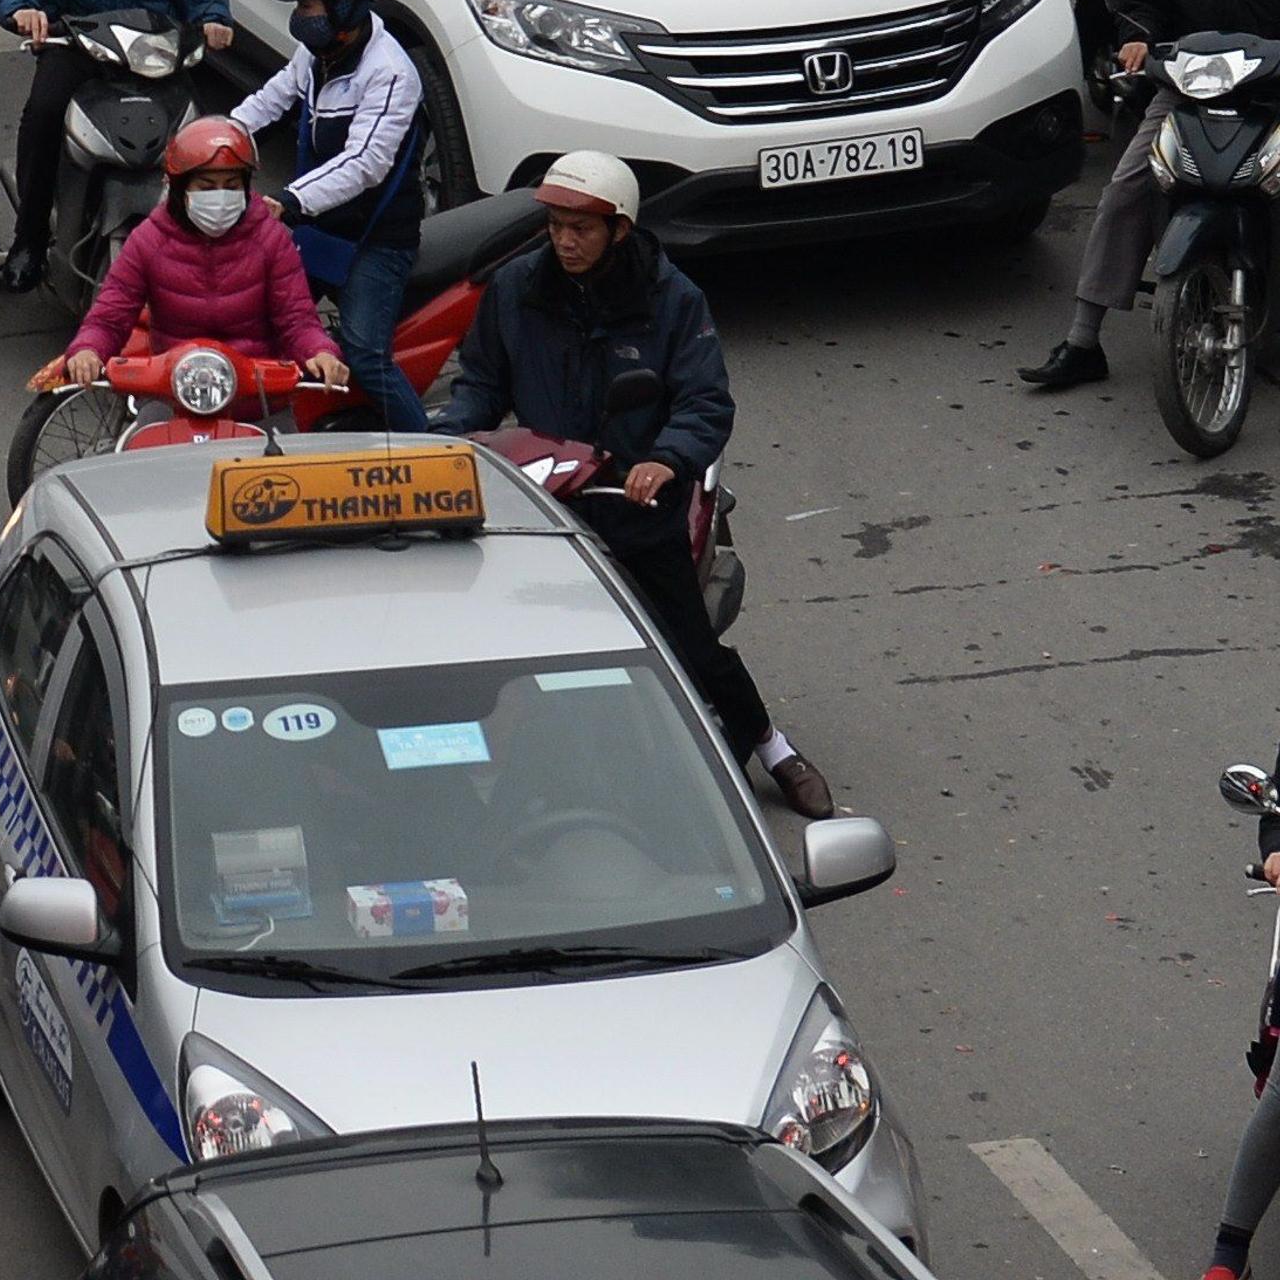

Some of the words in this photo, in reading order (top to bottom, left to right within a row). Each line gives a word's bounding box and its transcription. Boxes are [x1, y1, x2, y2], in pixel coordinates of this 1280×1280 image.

[764, 136, 918, 185] 30A-782.19
[346, 463, 413, 488] TAXI
[301, 490, 407, 523] THANH
[412, 487, 477, 516] NGA
[278, 712, 321, 732] 119
